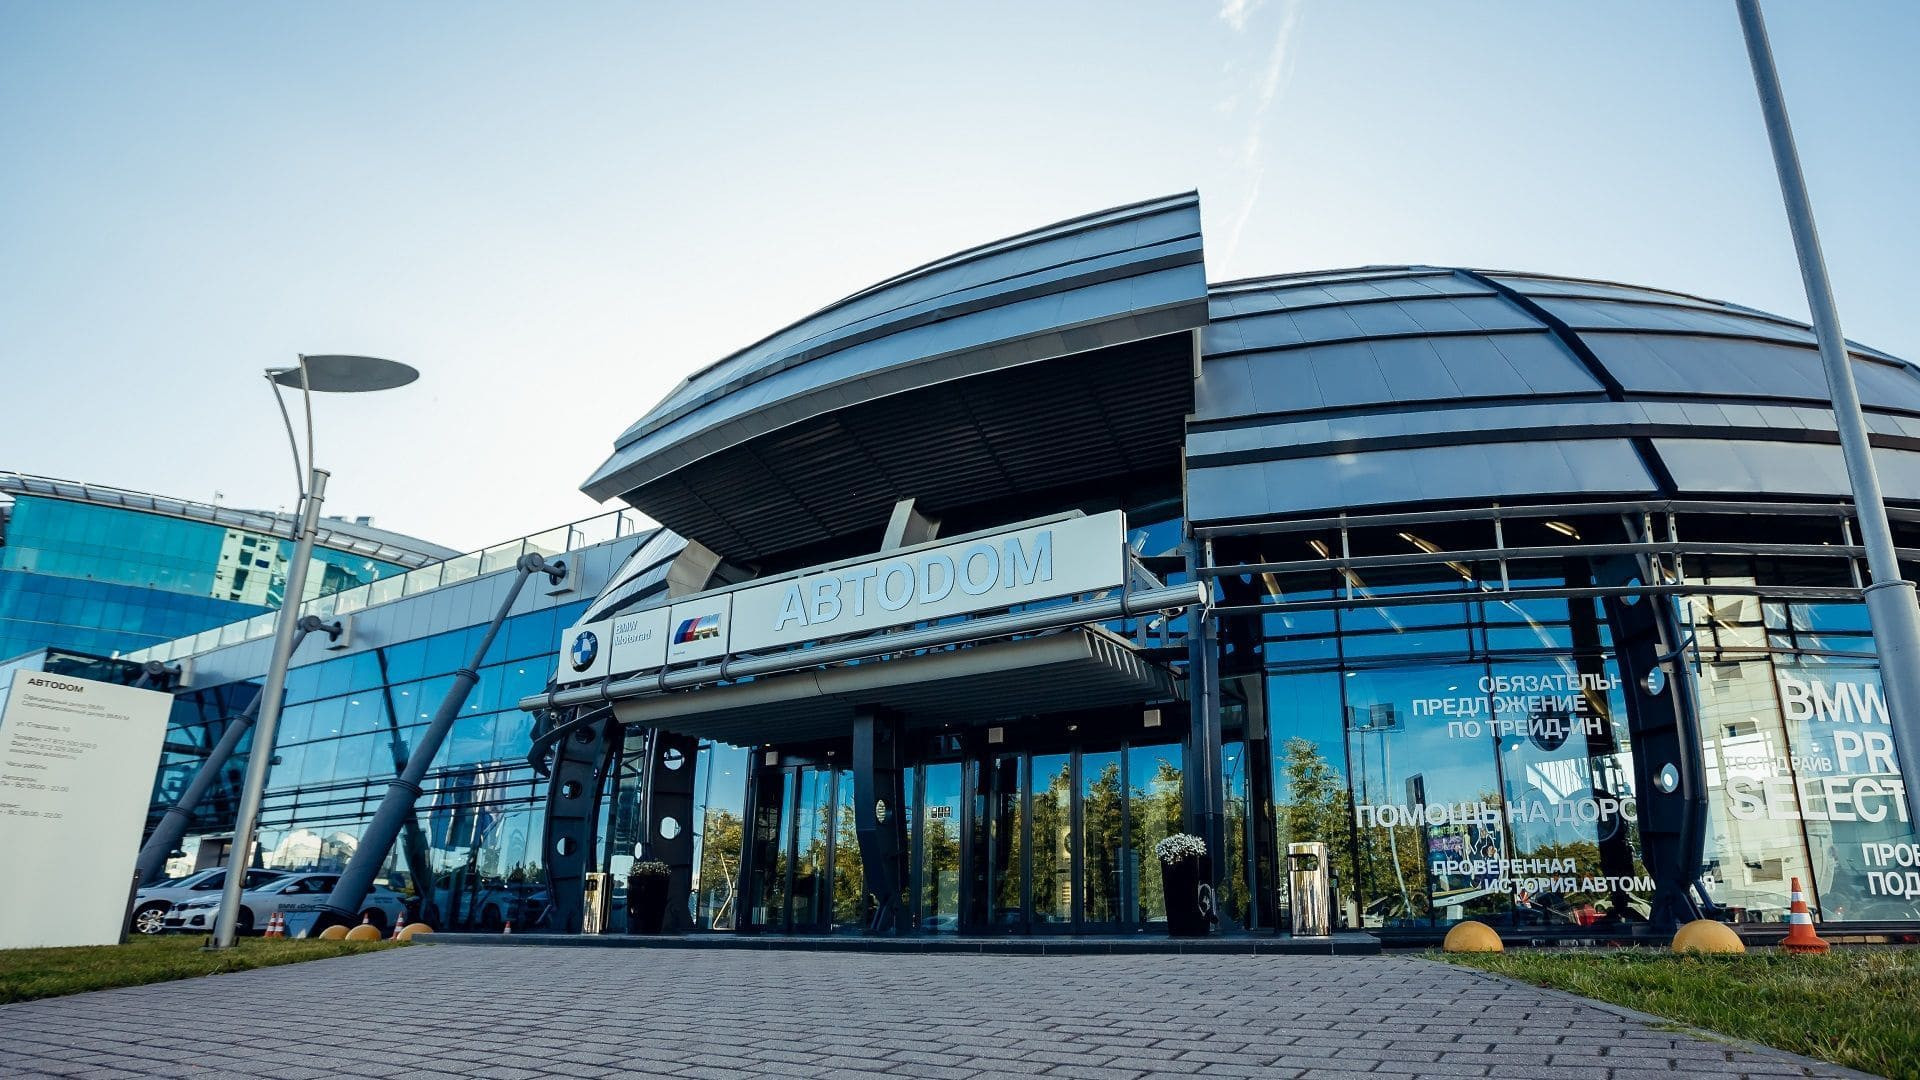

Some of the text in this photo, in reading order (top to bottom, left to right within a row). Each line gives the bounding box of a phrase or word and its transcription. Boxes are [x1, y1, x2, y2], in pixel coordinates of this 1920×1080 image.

[614, 629, 653, 647] Motorrad
[615, 620, 639, 635] BMW
[1412, 694, 1588, 717] ПРЕДЛОЖЕНИЕ
[1779, 678, 1891, 725] BMW
[1448, 714, 1603, 739] ПО ТРЕЙД-ИН
[1725, 775, 1909, 823] SELECT
[1355, 801, 1502, 828] ПОМОЩЬ
[1506, 799, 1550, 824] НА
[1432, 857, 1577, 876] ПРОВЕРЕННАЯ
[1484, 876, 1577, 894] ИСТОРИЯ
